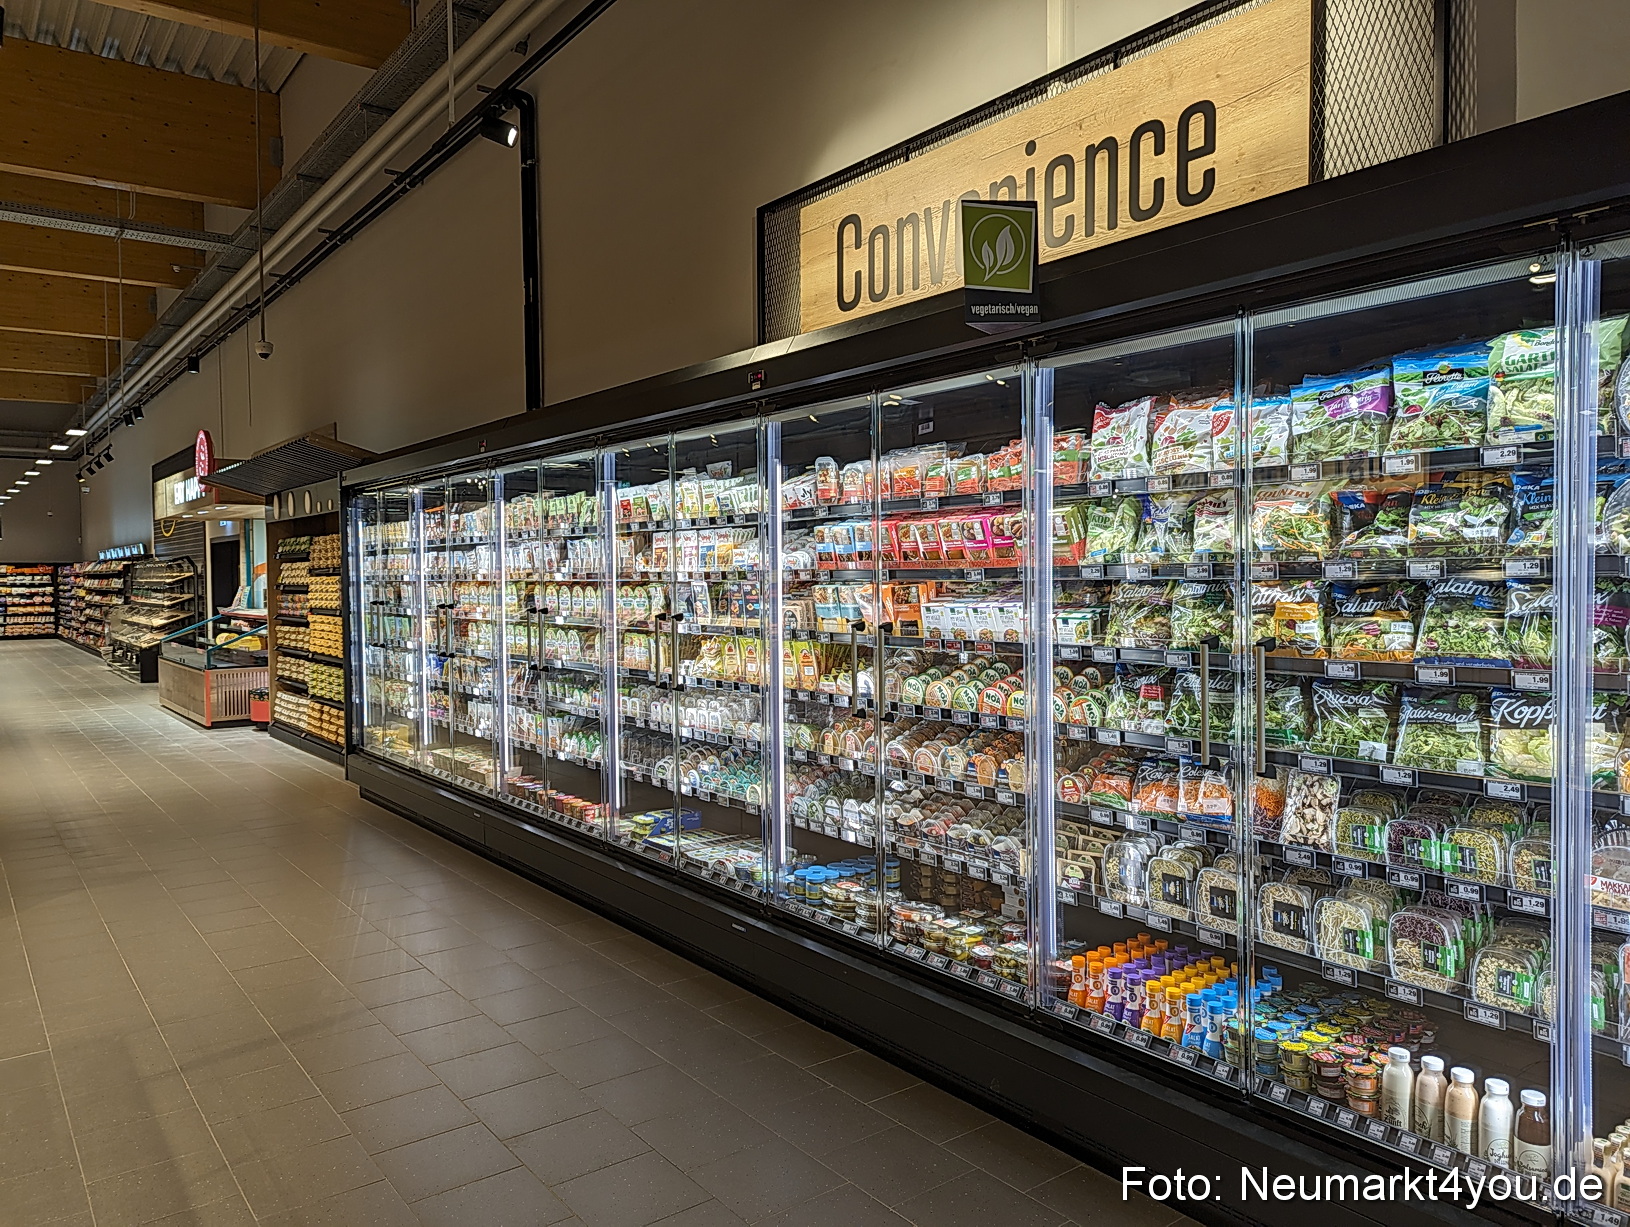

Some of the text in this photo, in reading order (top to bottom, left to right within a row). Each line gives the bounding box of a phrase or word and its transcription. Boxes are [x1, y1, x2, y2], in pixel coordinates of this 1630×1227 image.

[837, 100, 1216, 312] Convience
[971, 302, 1039, 317] vegetarisch/vegan
[1425, 372, 1464, 384] Florette
[1304, 467, 1317, 475] 1.99
[1256, 488, 1313, 498] COUNTRY
[1421, 493, 1447, 505] Klein
[1523, 492, 1552, 505] Klein
[1427, 577, 1508, 597] Salatmix
[1331, 597, 1398, 618] Salatmix
[1532, 676, 1549, 684] 1.99
[907, 681, 920, 692] NOA
[985, 691, 1000, 706] NOA
[1013, 697, 1025, 705] NO
[1503, 785, 1520, 793] 2.49
[1349, 863, 1362, 871] 0.99
[1404, 874, 1419, 882] 0.99
[1463, 886, 1479, 895] 0.99
[1528, 900, 1545, 908] 1.29
[1402, 989, 1417, 998] 1.29
[1484, 1011, 1499, 1020] 1.29
[1181, 1053, 1193, 1062] 0.99
[1600, 1213, 1620, 1226] 1.49
